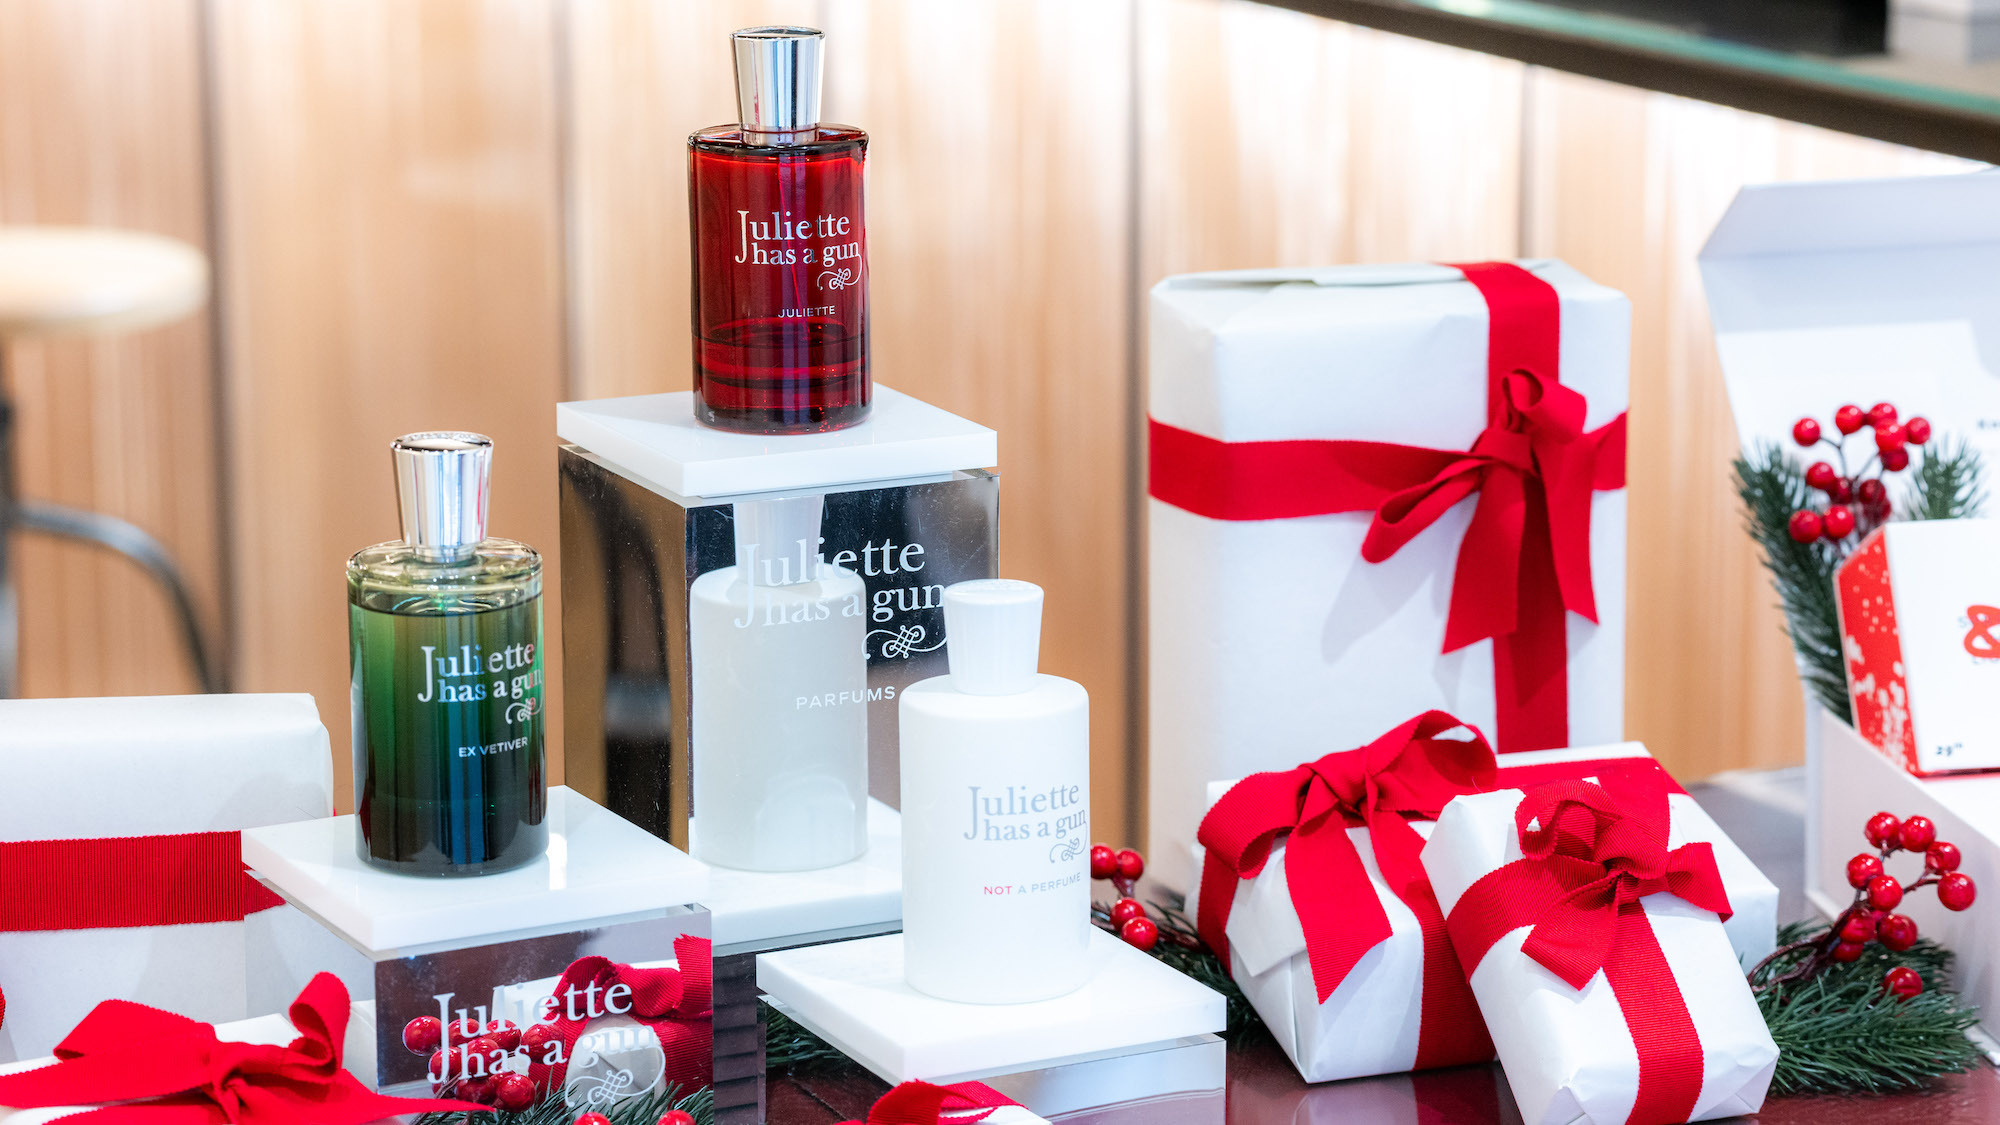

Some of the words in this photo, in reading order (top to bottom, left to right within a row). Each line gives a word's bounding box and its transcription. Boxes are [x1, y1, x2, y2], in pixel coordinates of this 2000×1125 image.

[735, 209, 850, 264] Juliette
[751, 242, 797, 265] has
[803, 246, 818, 264] a
[822, 241, 862, 267] gun
[777, 305, 836, 319] JULIETTE
[734, 536, 925, 629] Juliette
[762, 591, 831, 627] has
[841, 592, 864, 618] a
[872, 584, 946, 623] gun
[417, 642, 534, 703] Juliette
[437, 679, 487, 703] has
[493, 680, 508, 698] a
[511, 668, 543, 700] gun
[795, 685, 896, 711] PARFUMS
[458, 746, 477, 758] EX
[479, 736, 529, 756] VETIVER
[963, 784, 1080, 841] Juliette
[983, 818, 1031, 842] has
[1037, 821, 1051, 838] a
[1055, 809, 1087, 840] gun
[983, 885, 1013, 896] NOT
[1017, 885, 1027, 895] A
[1031, 871, 1082, 894] PERFUME
[426, 979, 634, 1085] Juliette
[456, 1042, 533, 1081] has
[542, 1039, 568, 1066] a
[578, 1025, 658, 1069] gun
